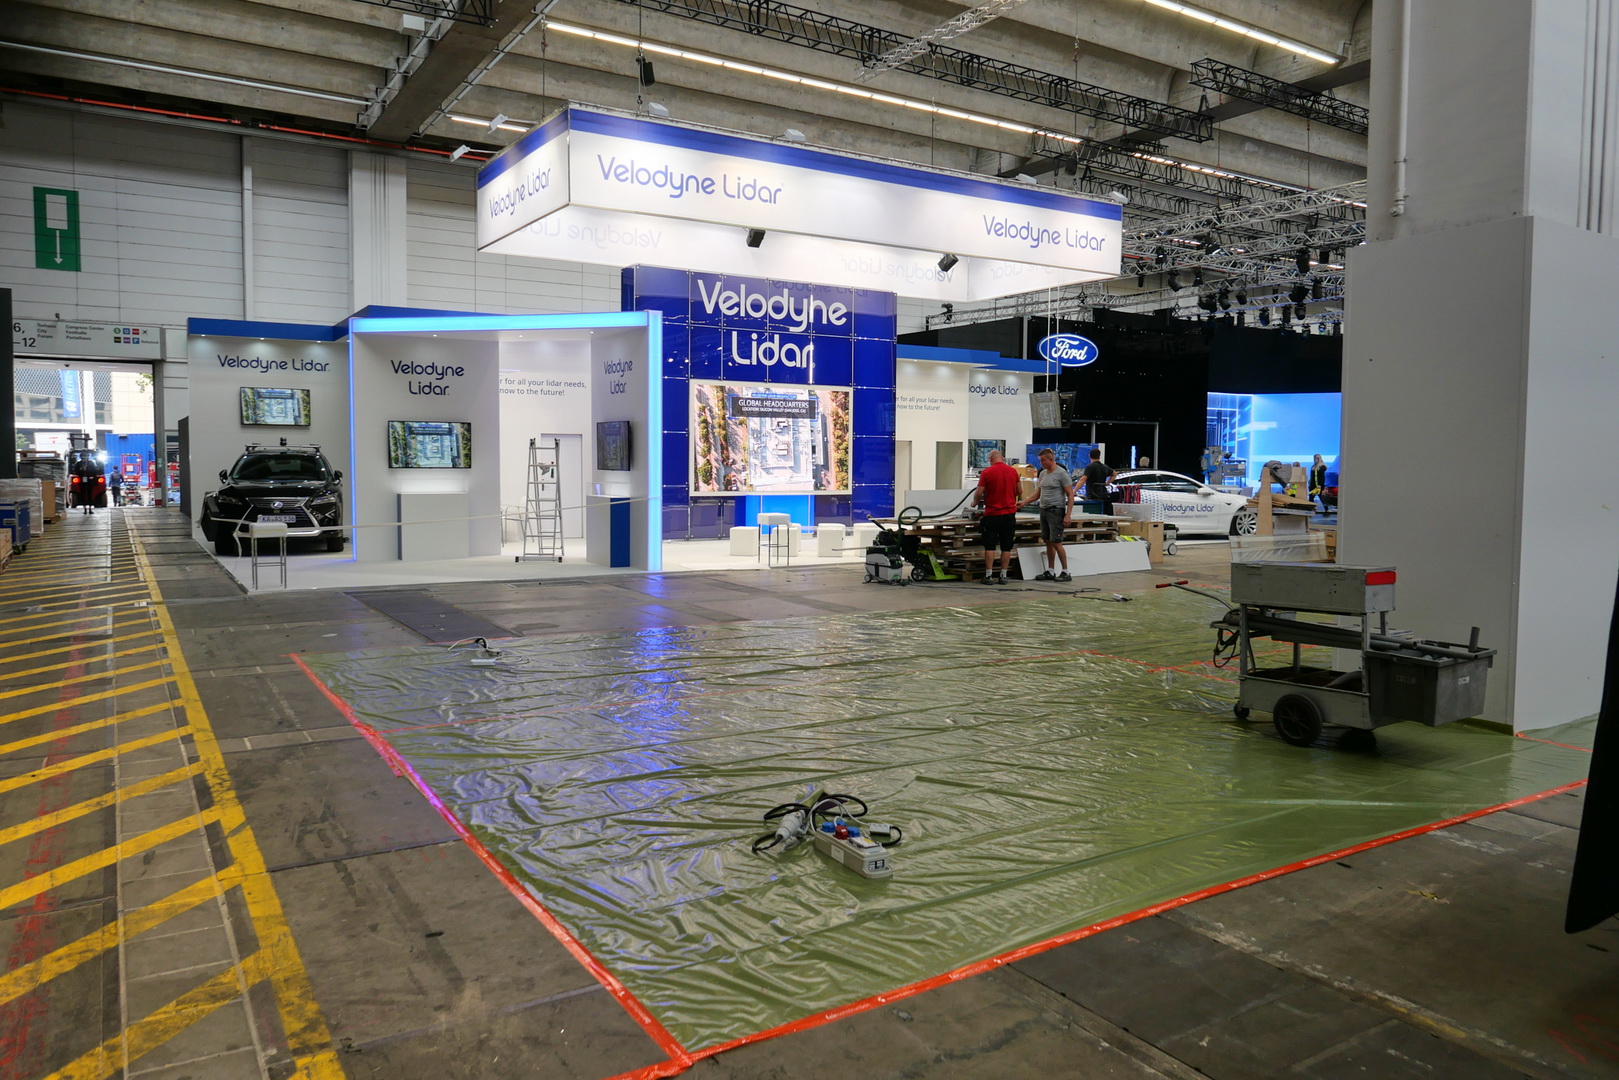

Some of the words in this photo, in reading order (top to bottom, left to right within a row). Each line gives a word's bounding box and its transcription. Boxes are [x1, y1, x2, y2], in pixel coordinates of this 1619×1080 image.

[598, 154, 715, 198] Velodyne
[722, 174, 781, 204] Lidar
[489, 184, 526, 219] Velodyne
[527, 168, 550, 196] Lidar
[984, 215, 1060, 248] Velodyne
[1066, 228, 1105, 251] Lidar
[698, 280, 847, 332] Velodyne
[732, 331, 814, 367] Lidar
[1052, 338, 1088, 361] Ford
[218, 355, 288, 373] Velodyne
[292, 359, 329, 372] Lidar
[390, 360, 464, 380] Velodyne
[604, 359, 633, 377] Velodyne
[409, 381, 449, 395] Lidar
[540, 388, 564, 396] future!
[610, 380, 626, 394] Lidar
[998, 384, 1019, 396] Lidar
[1163, 504, 1195, 514] Velodyne
[1196, 504, 1214, 512] Lidar
